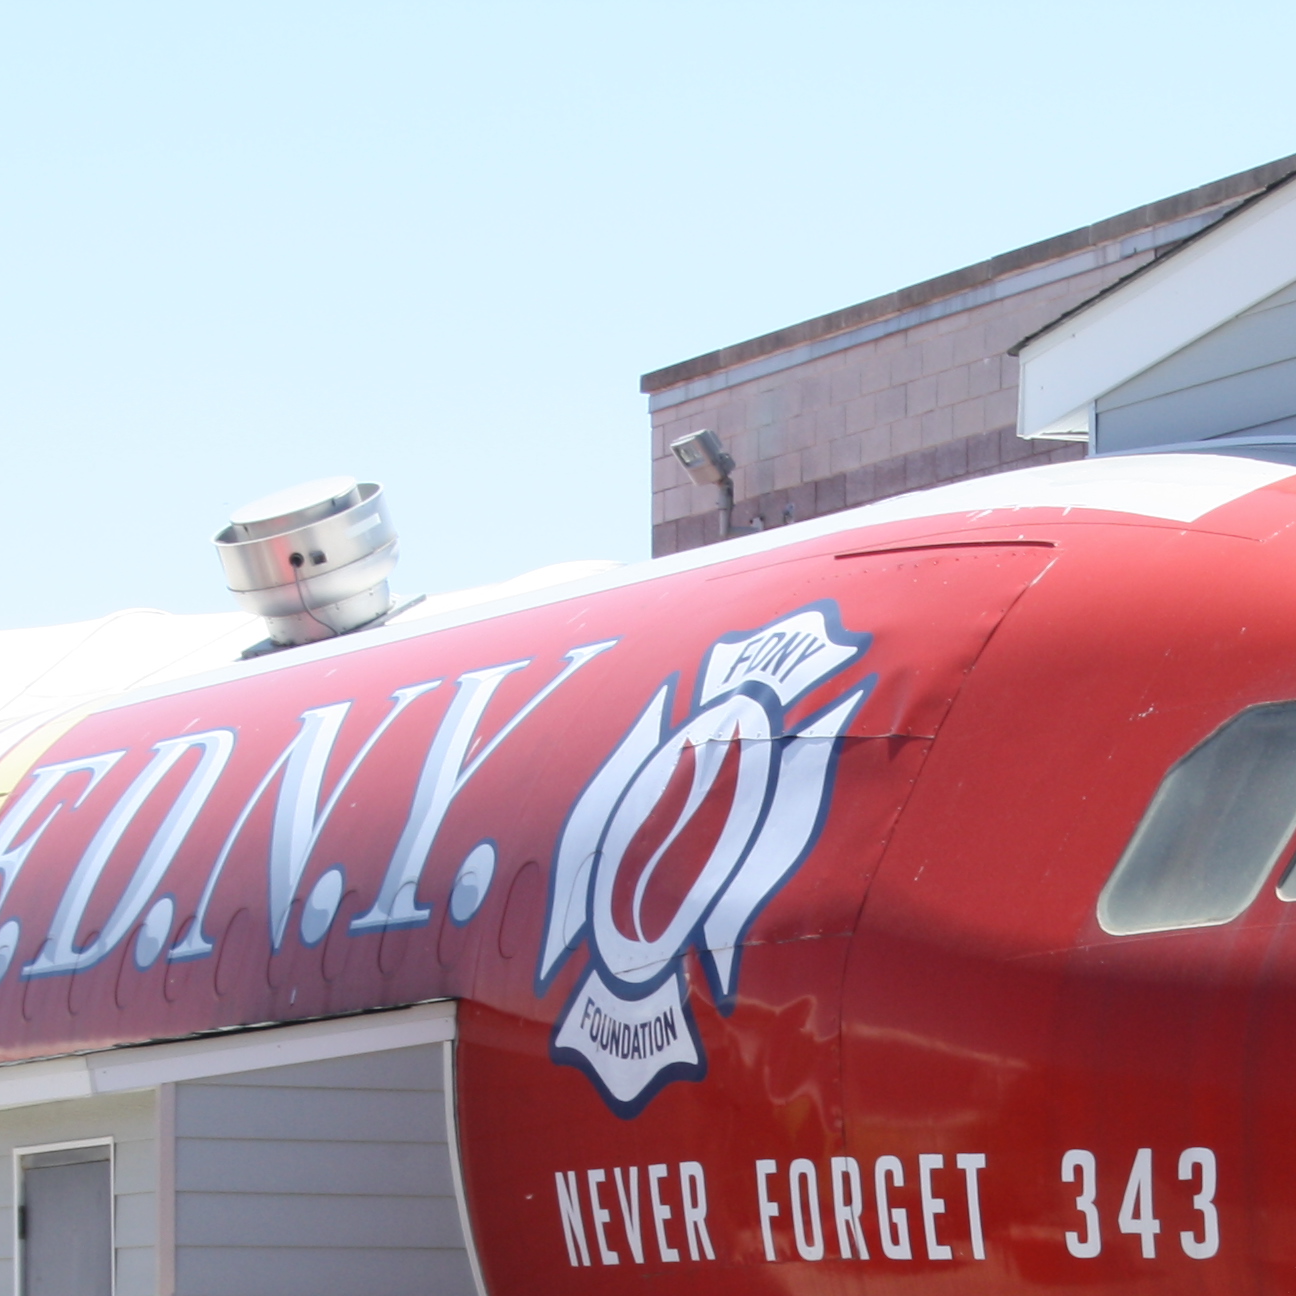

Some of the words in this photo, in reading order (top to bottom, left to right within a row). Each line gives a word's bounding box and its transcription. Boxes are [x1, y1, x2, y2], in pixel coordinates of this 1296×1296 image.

[722, 630, 827, 686] FDNY
[580, 996, 677, 1061] FOUNDATION
[555, 1160, 716, 1267] NEVER
[756, 1153, 987, 1261] FORGET
[1060, 1147, 1220, 1260] 343
